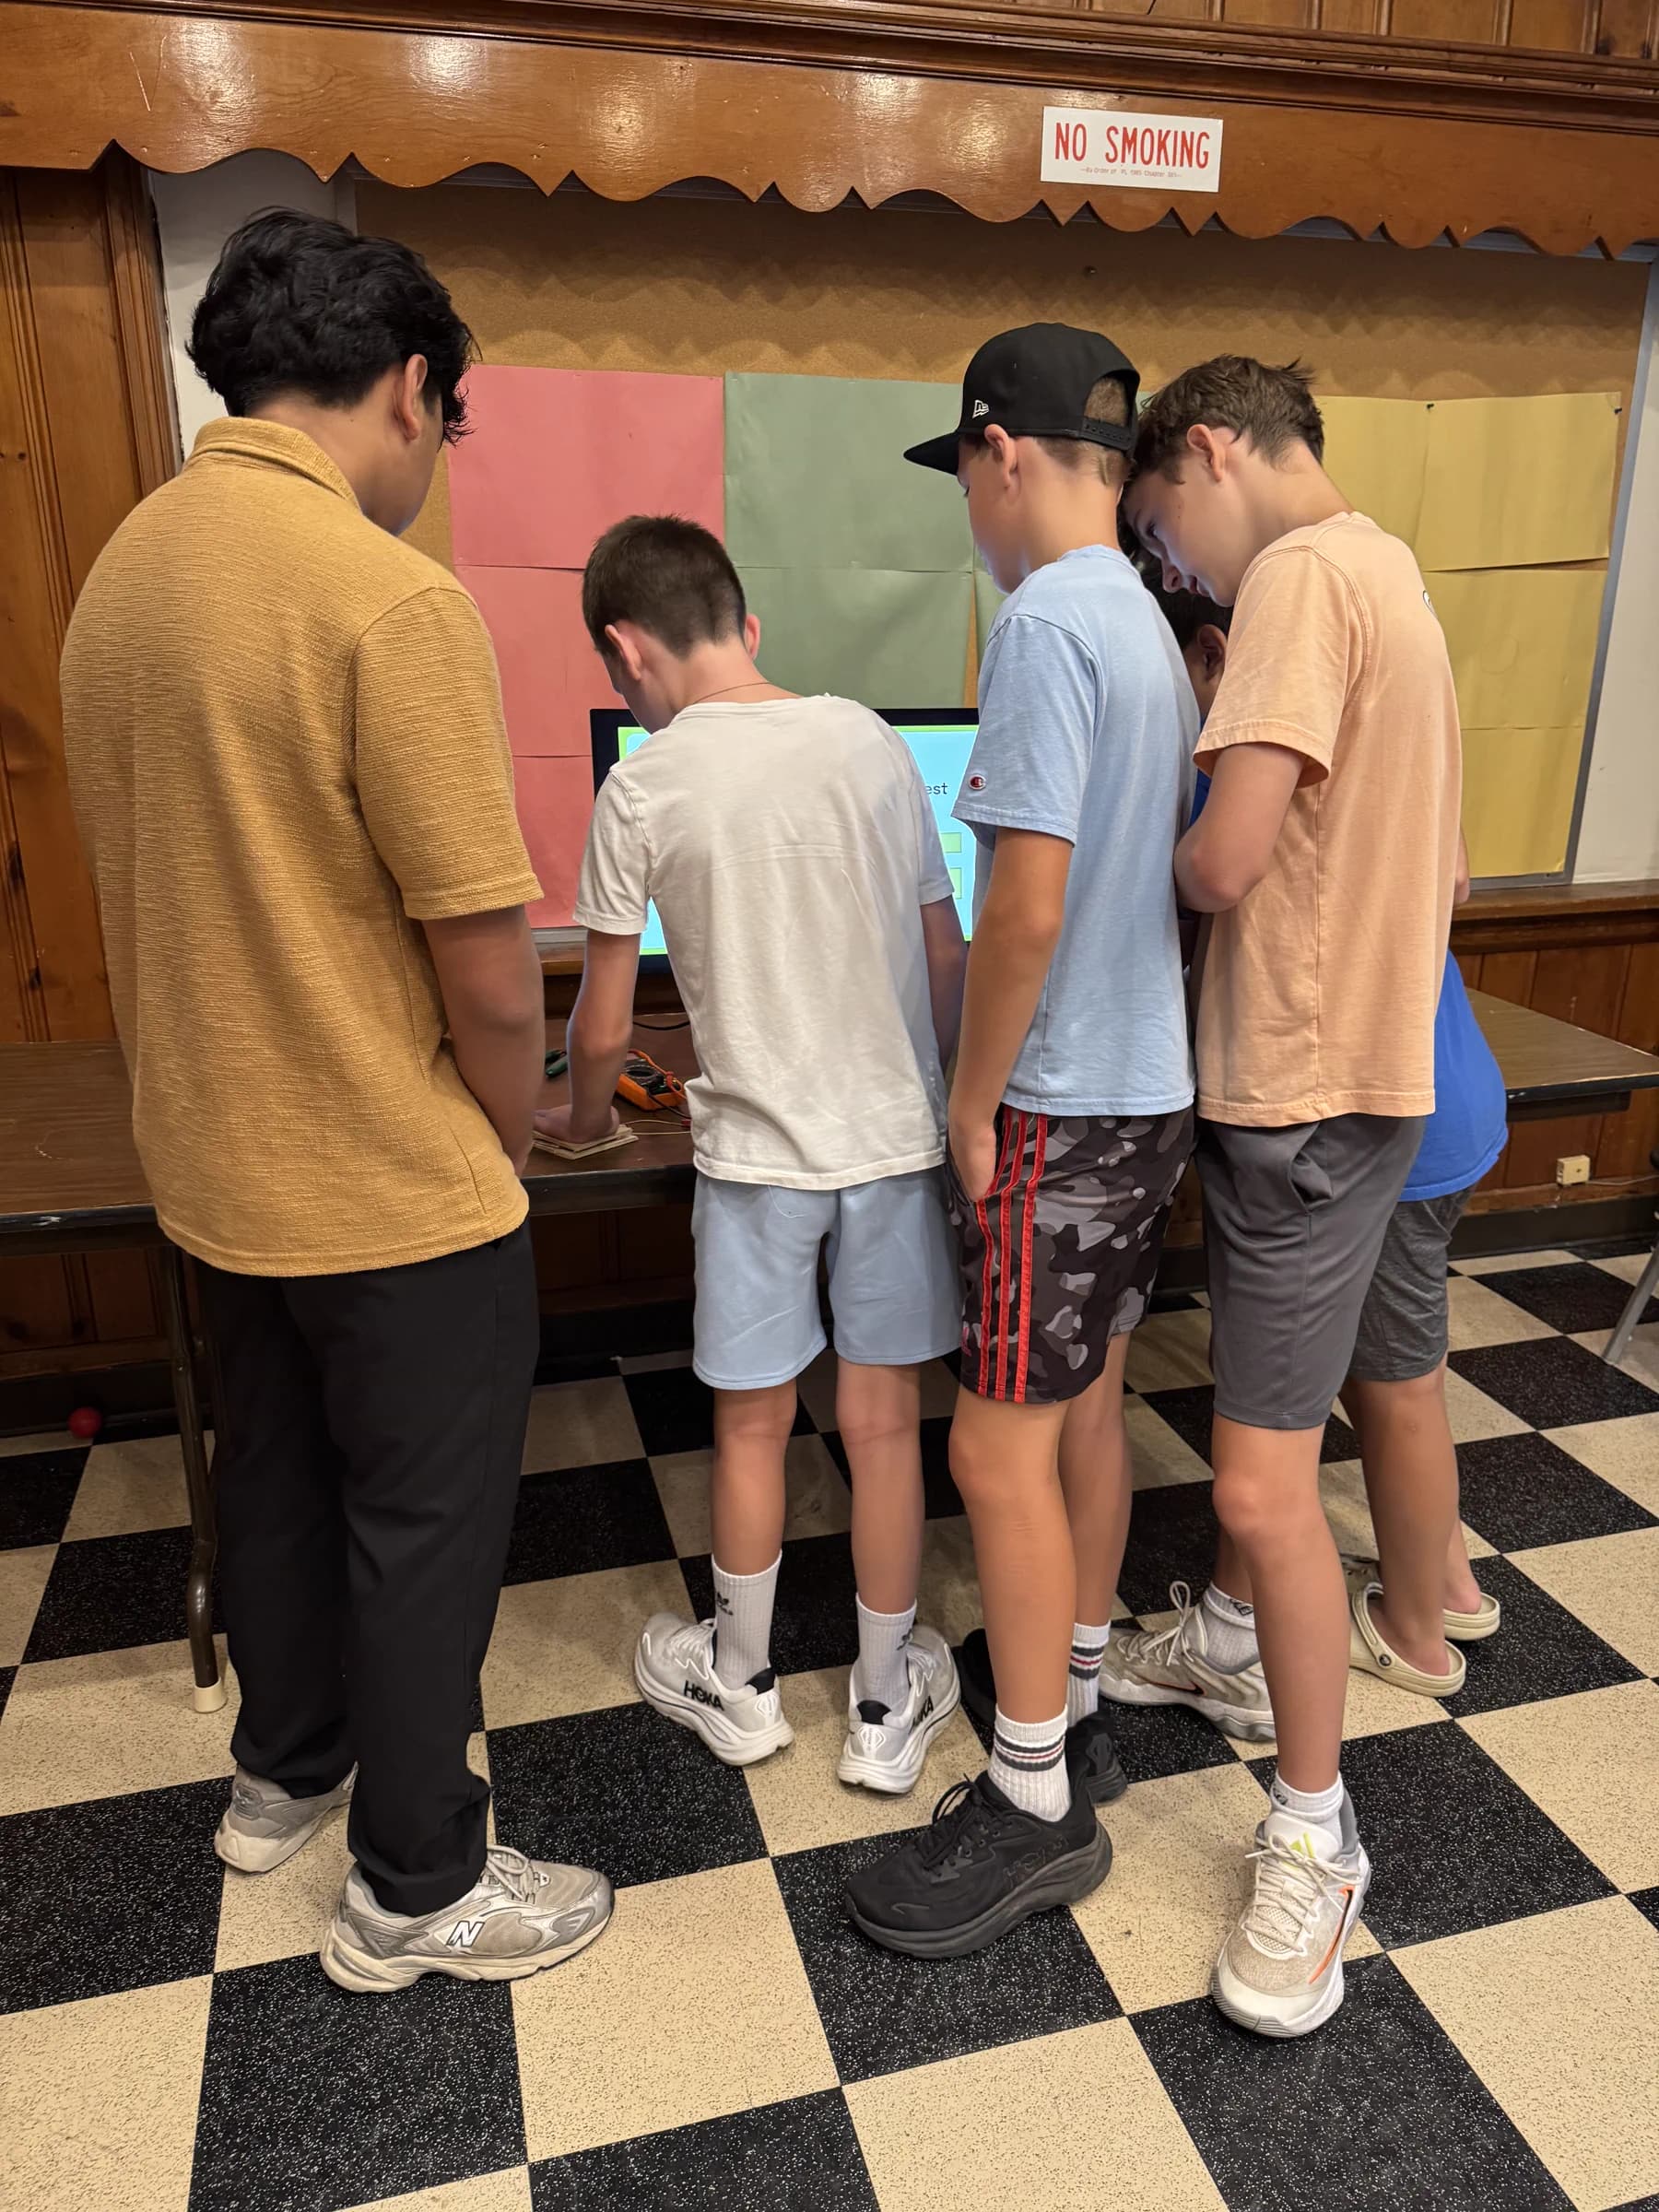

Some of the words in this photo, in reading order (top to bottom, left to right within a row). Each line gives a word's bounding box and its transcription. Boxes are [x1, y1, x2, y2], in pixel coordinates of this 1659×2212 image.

[1054, 122, 1088, 161] NO
[1105, 125, 1210, 169] SMOKING
[683, 1679, 724, 1712] HOKA
